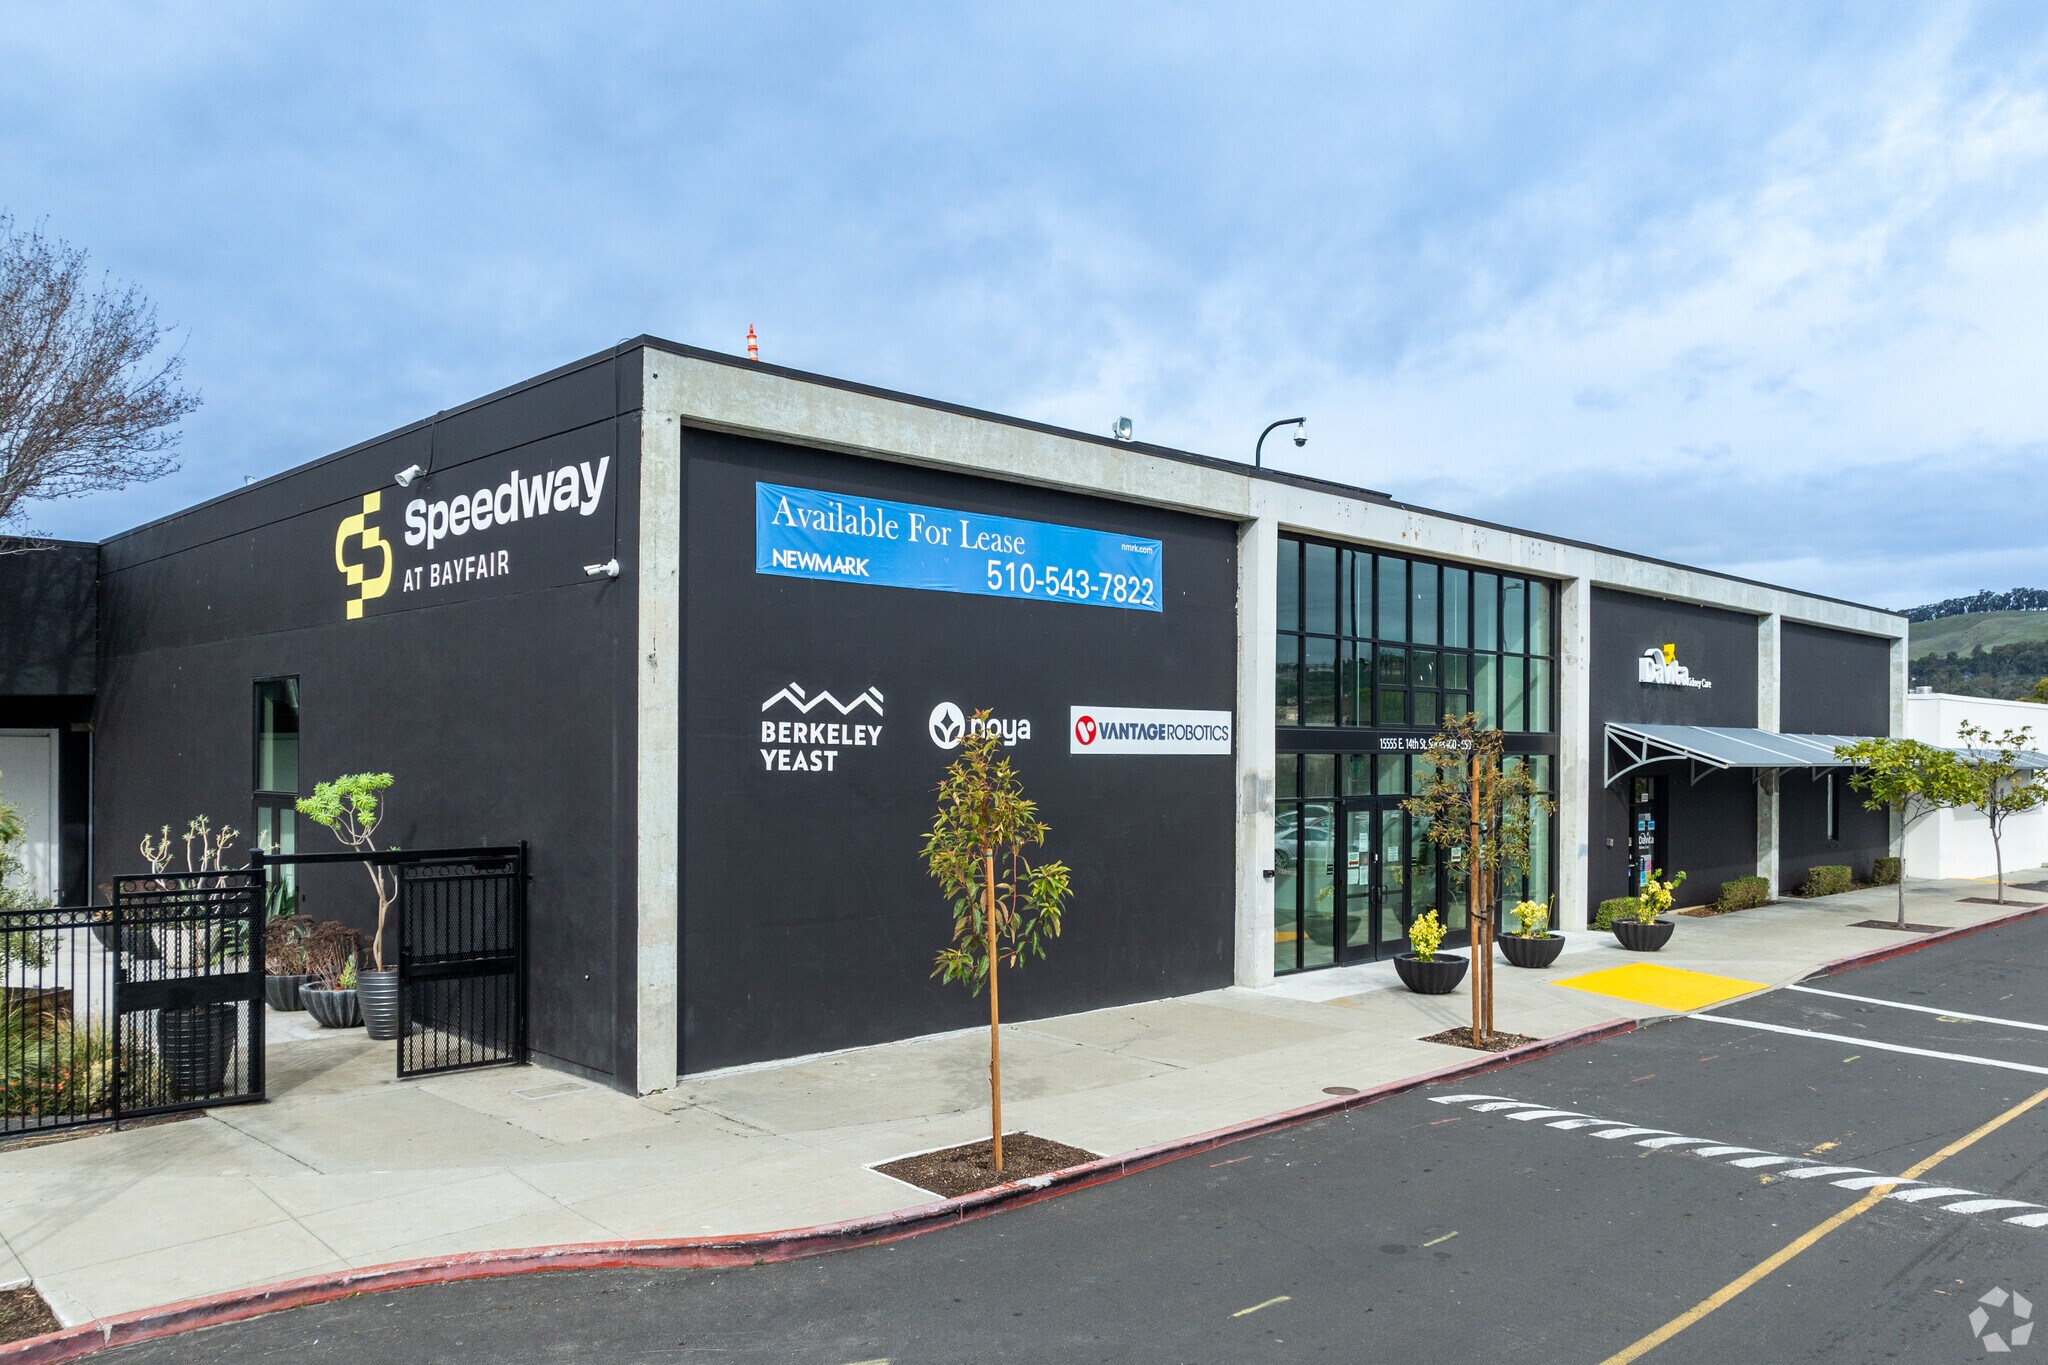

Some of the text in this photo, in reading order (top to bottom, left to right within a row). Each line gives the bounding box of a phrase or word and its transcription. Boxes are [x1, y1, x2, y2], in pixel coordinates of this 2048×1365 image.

[405, 456, 610, 550] Speedway
[771, 496, 1025, 554] Available For Lease
[773, 548, 869, 577] NEWMARK
[1121, 543, 1153, 555] nmrk.com
[403, 550, 510, 592] AT BAYFAIR
[987, 559, 1154, 606] 510-543-7822
[761, 721, 883, 746] BERKELEY
[970, 718, 1031, 747] noya
[1380, 737, 1398, 750] 15555
[1398, 737, 1405, 750] E.
[1406, 737, 1419, 750] 14th
[760, 749, 838, 771] YEAST
